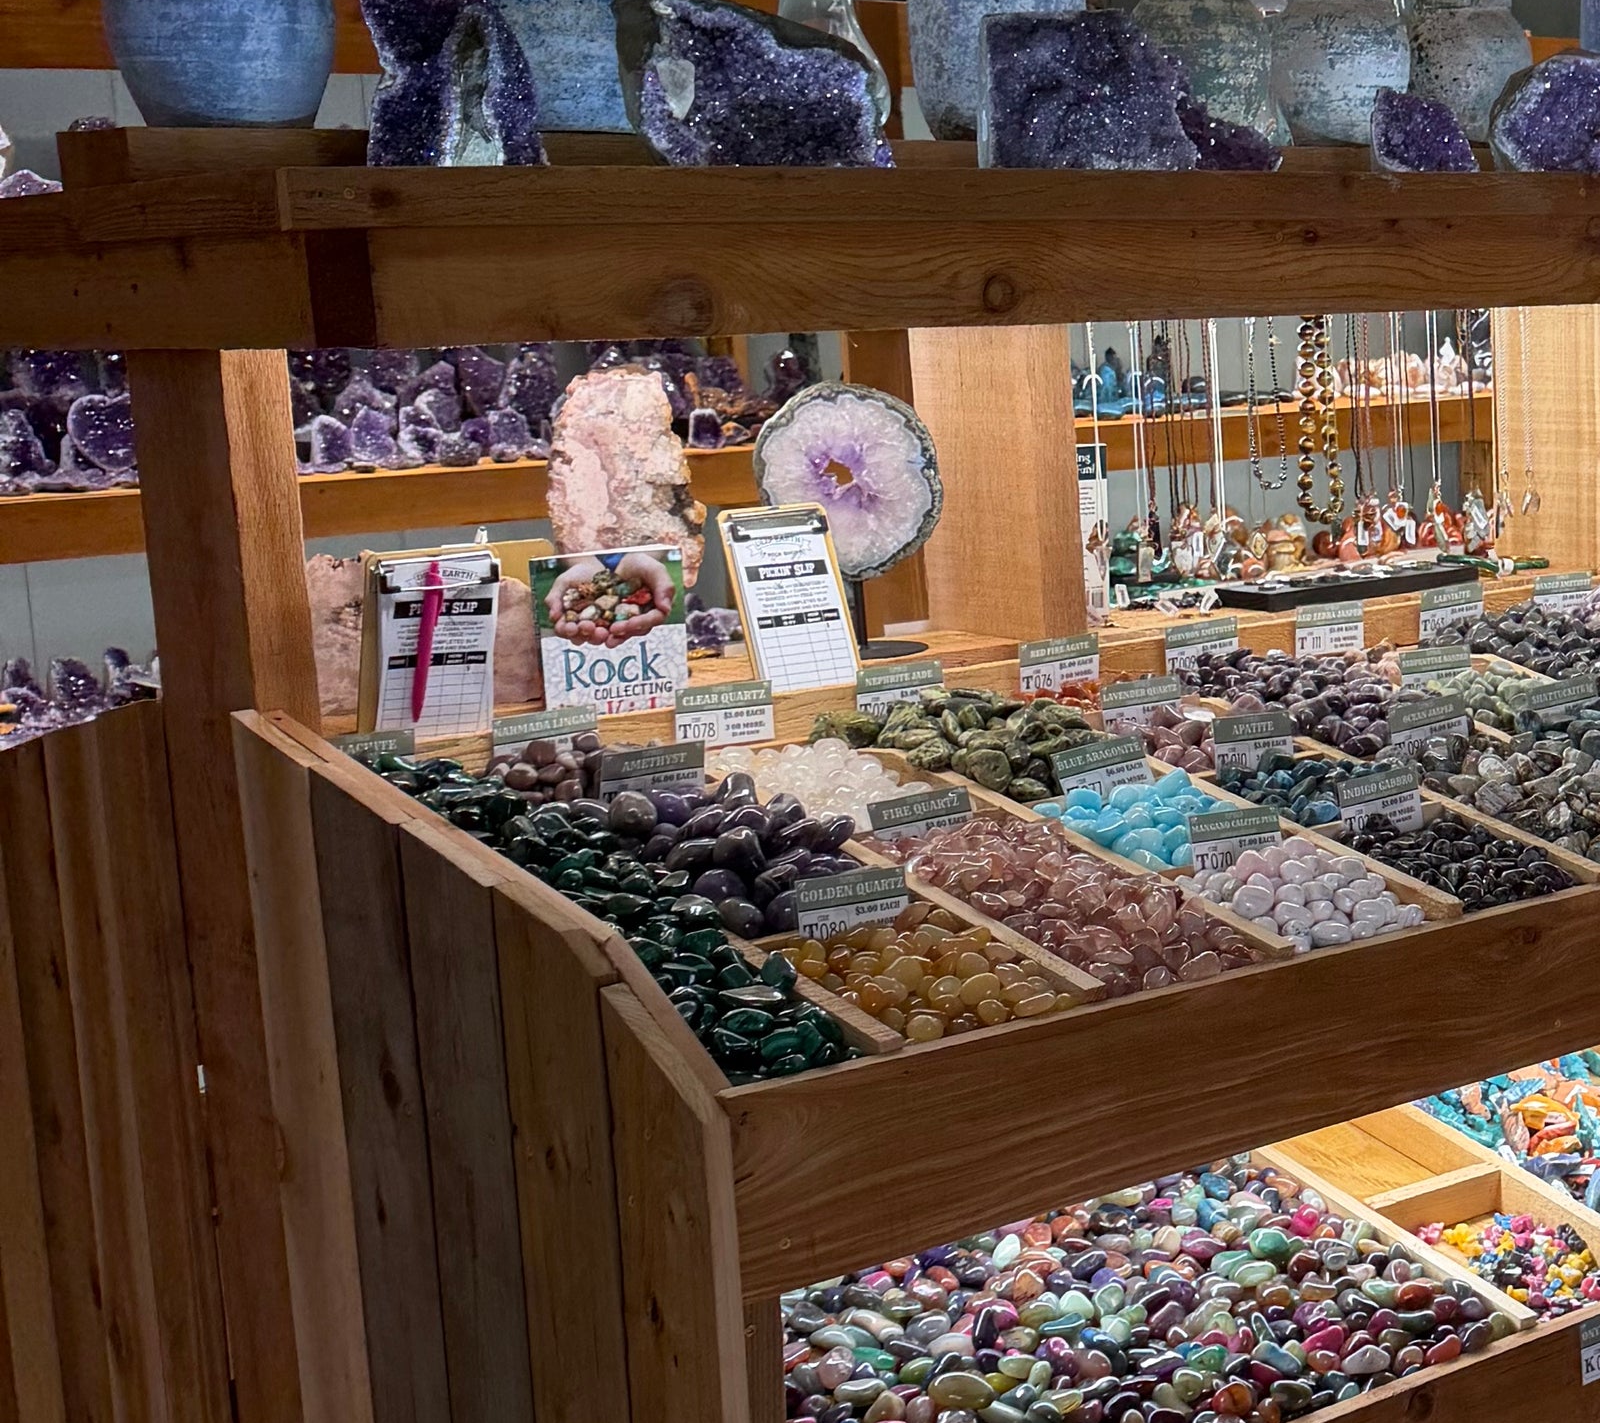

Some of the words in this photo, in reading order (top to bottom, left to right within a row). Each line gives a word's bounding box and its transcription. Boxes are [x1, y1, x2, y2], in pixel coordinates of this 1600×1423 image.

[442, 569, 474, 580] EARTH
[795, 563, 815, 575] SLIP
[452, 602, 478, 614] SLIP
[1030, 649, 1046, 658] RED
[1047, 646, 1066, 655] FIRE
[562, 641, 666, 693] Rock
[865, 673, 910, 686] NEPHRITE
[912, 670, 933, 680] JADE
[594, 681, 673, 701] COLLECTING
[683, 694, 719, 706] CLEAR
[720, 689, 767, 703] QUARTZ
[1103, 689, 1146, 702] LAVENDER
[1147, 684, 1177, 696] QUARTZ
[494, 721, 551, 738] NARMADA
[552, 713, 595, 729] LINGAM
[678, 722, 716, 739] T078
[1233, 721, 1274, 735] APATITE
[621, 752, 687, 772] AMETHYST
[1056, 755, 1086, 771] BLUE
[1086, 742, 1141, 763] ARAGONITE
[1126, 762, 1144, 771] EACH
[676, 771, 698, 781] EACH
[1343, 783, 1377, 800] INDIGO
[1379, 773, 1413, 791] GABBRO
[882, 805, 912, 820] FIRE
[913, 796, 960, 815] QUARTZ
[1192, 821, 1231, 832] MANGANO
[1259, 835, 1276, 844] EACH
[1196, 851, 1233, 870] T070
[800, 885, 853, 903] GOLDEN
[856, 876, 904, 895] QUARTZ
[880, 901, 900, 912] EACH
